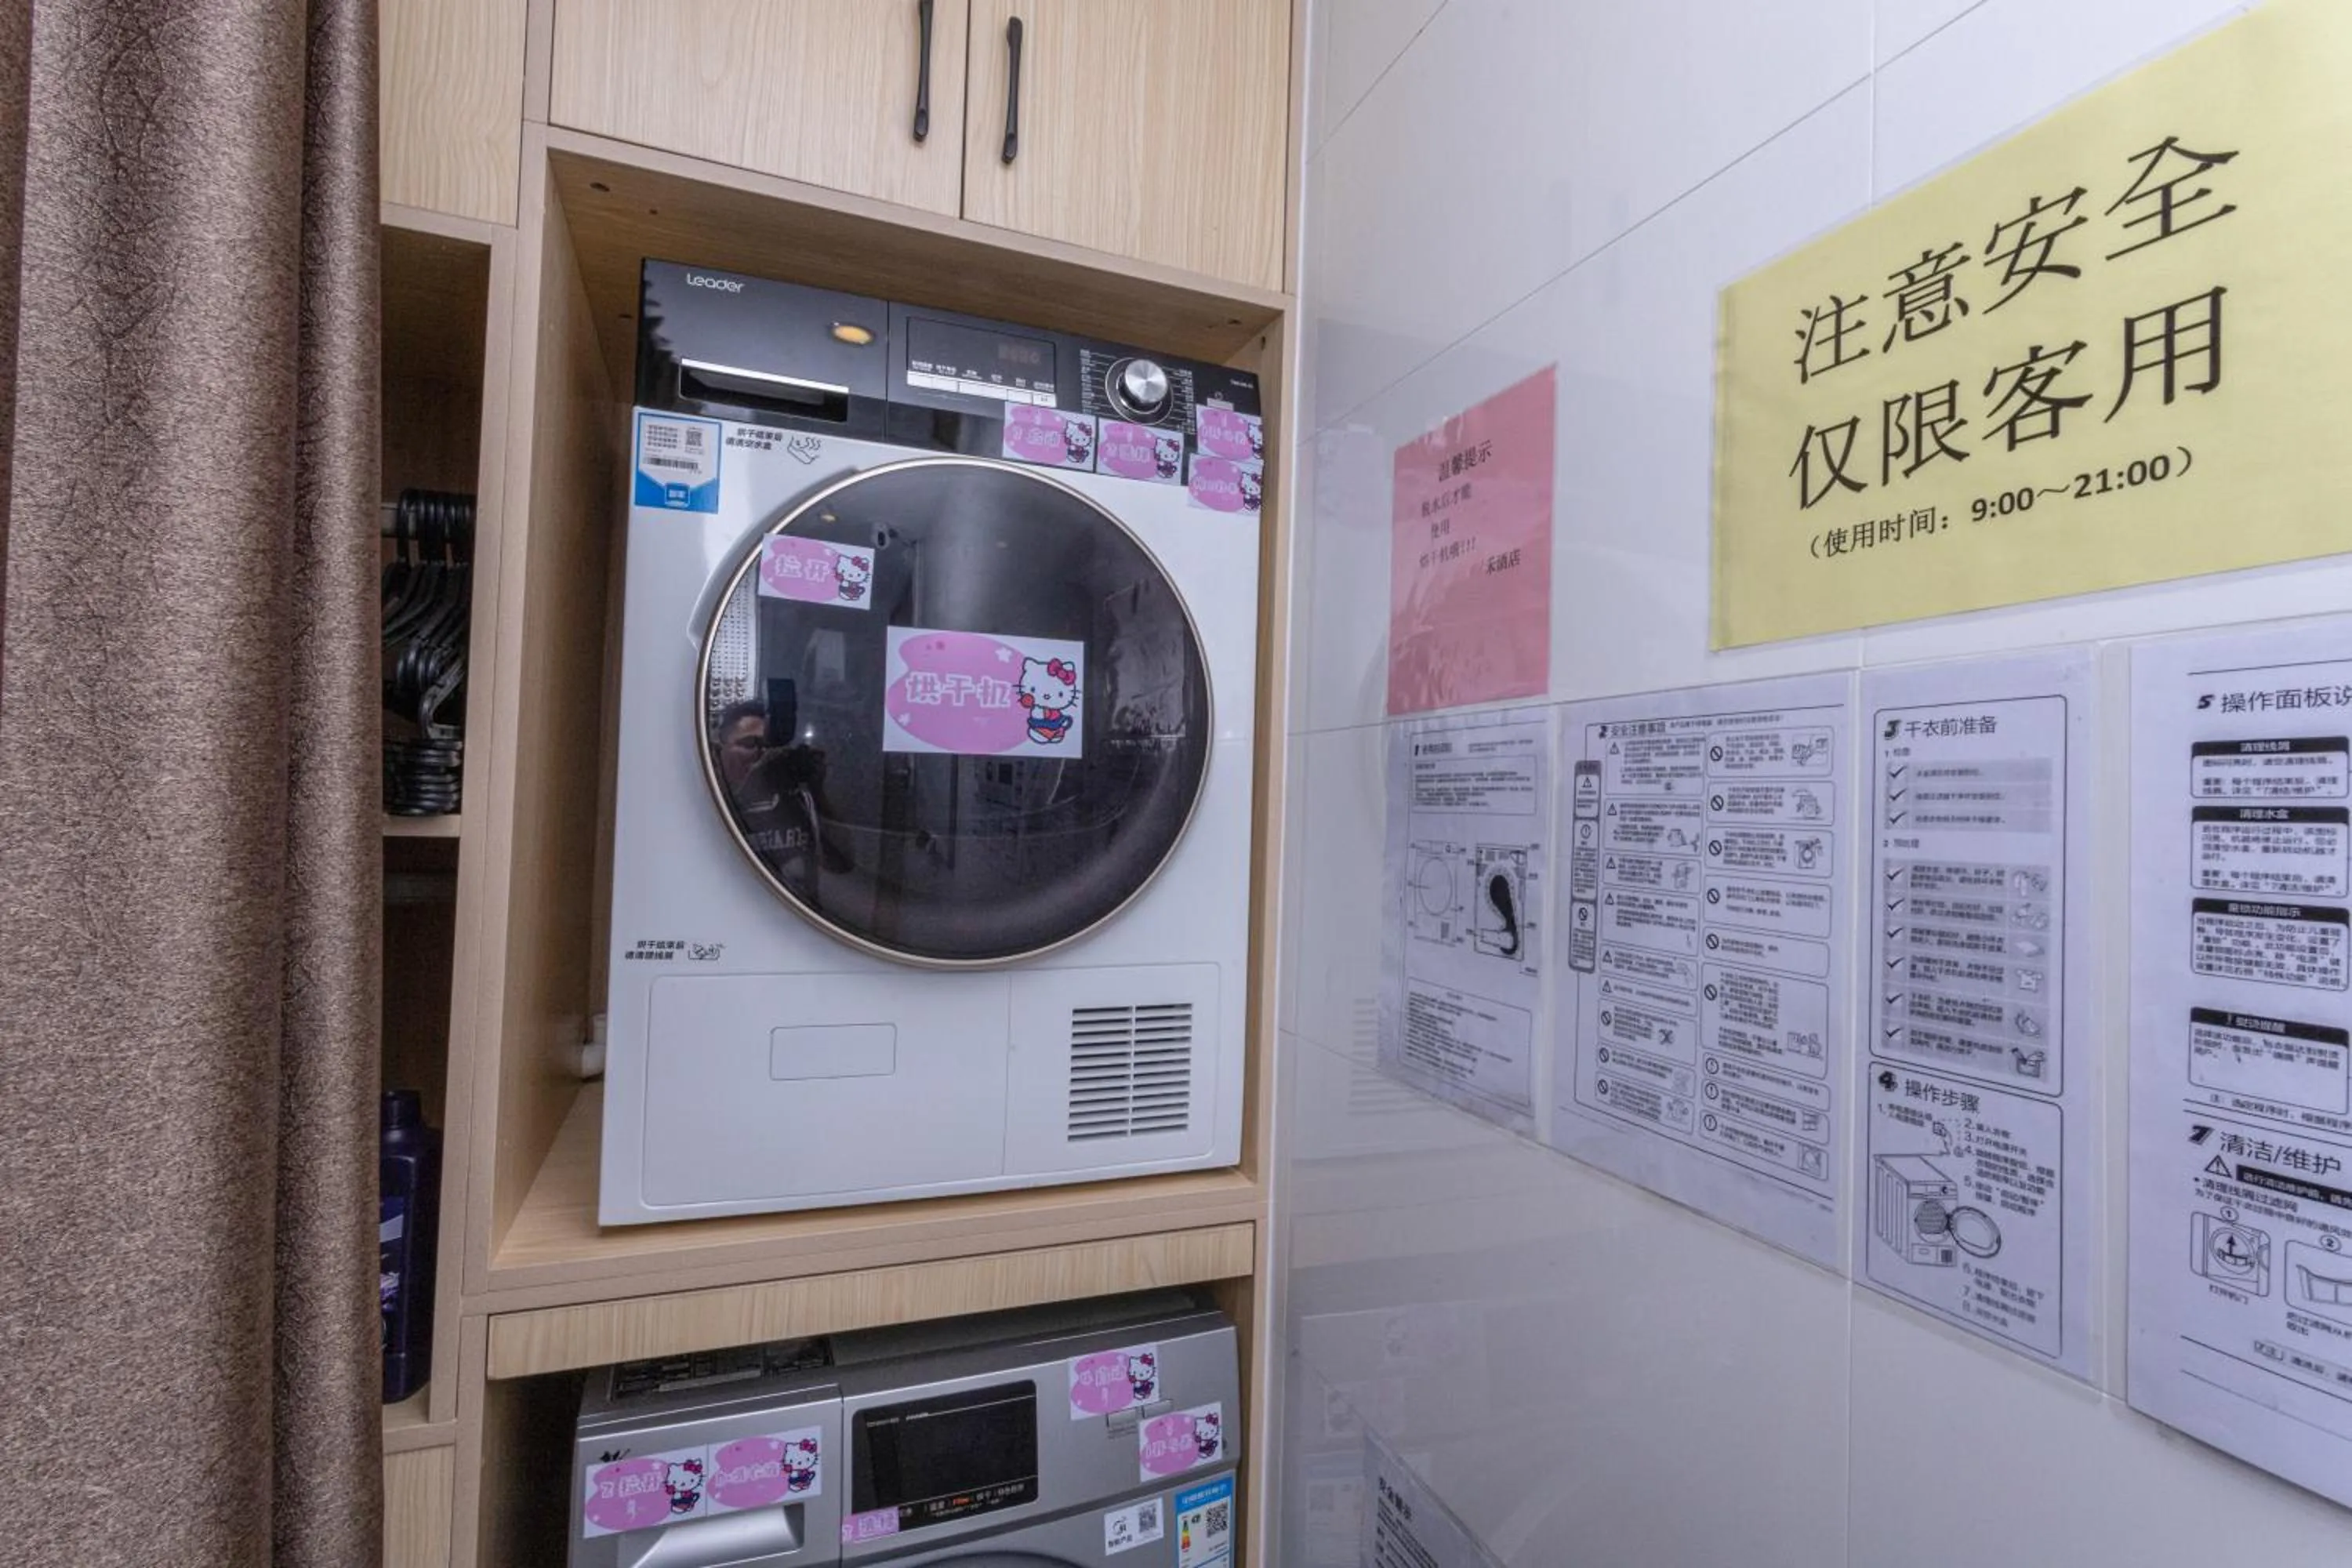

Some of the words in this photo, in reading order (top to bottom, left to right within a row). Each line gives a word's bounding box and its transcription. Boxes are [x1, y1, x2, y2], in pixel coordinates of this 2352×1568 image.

[1794, 136, 2240, 384] 注意安全
[687, 273, 745, 293] Leader
[1788, 286, 2228, 510] 仅限客用
[1439, 439, 1492, 483] 温馨提示
[906, 670, 1011, 709] 烘干机
[1904, 716, 1997, 739] 干衣前准备
[1904, 1078, 1980, 1114] 操作步骤
[2220, 1131, 2341, 1175] 清洁/维护
